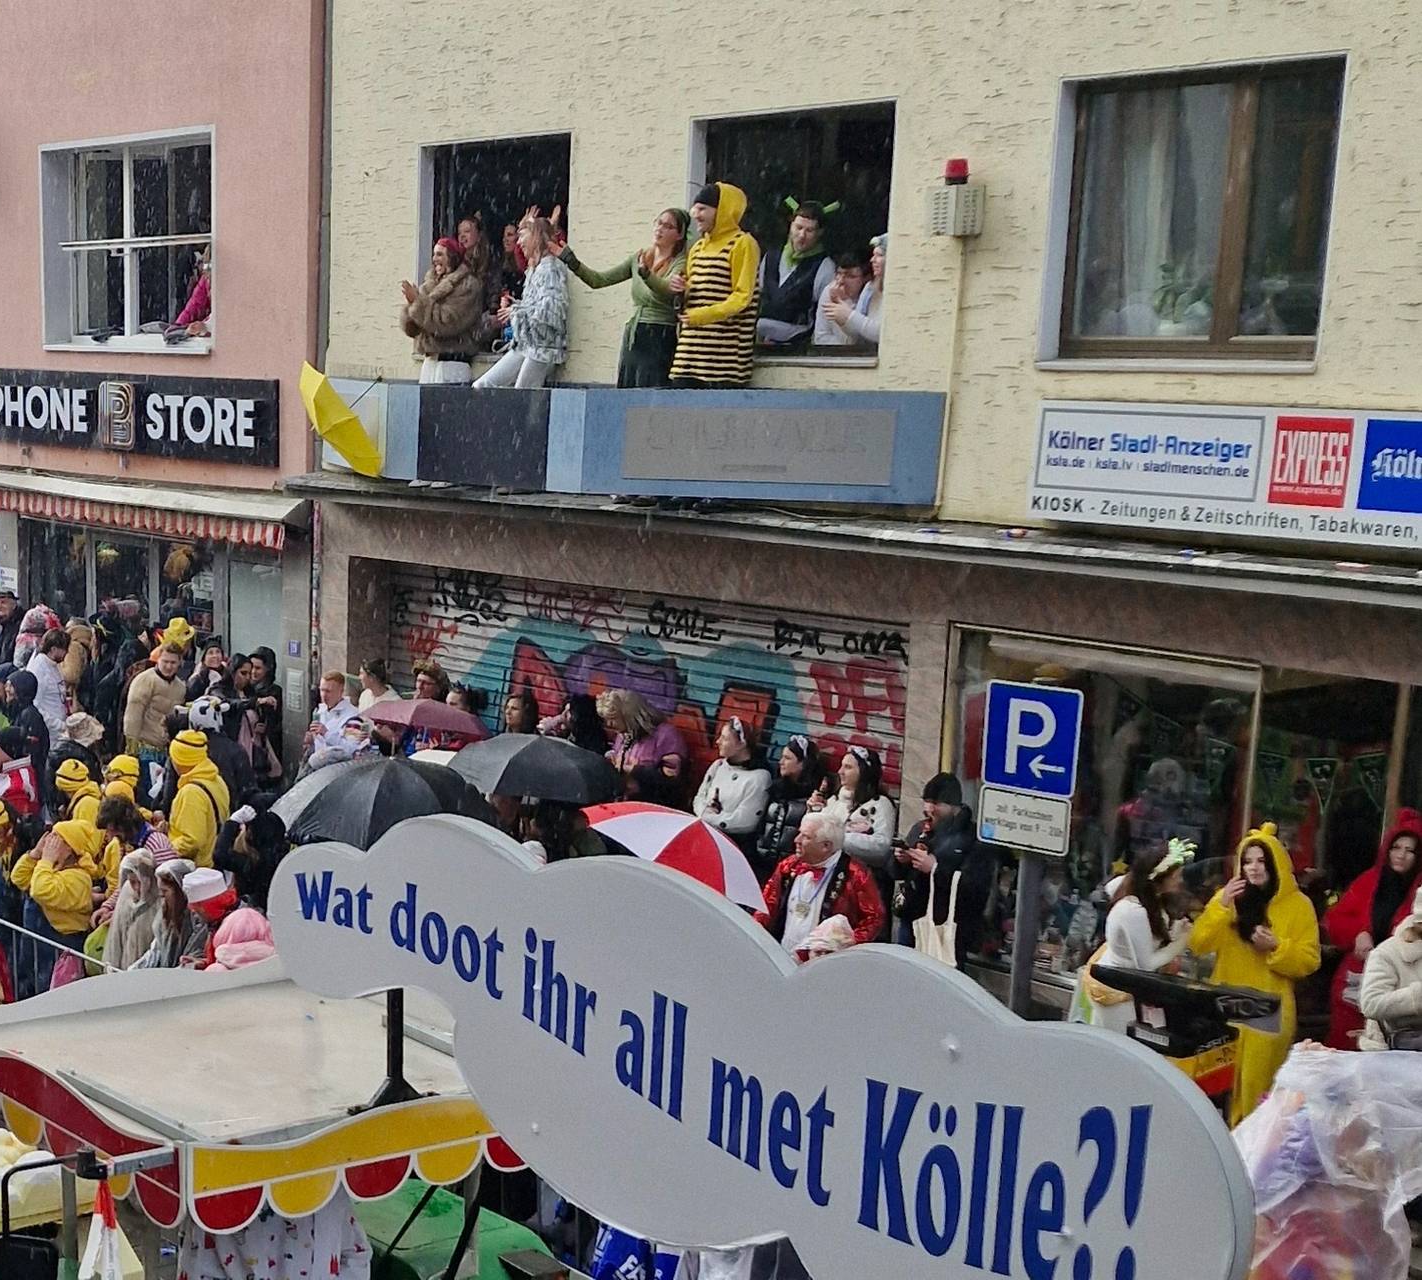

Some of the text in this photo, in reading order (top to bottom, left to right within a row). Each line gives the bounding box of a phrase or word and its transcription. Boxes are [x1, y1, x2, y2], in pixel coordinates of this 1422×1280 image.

[145, 393, 255, 448] STORE
[1048, 430, 1253, 463] Kölner Stadt-Anzeiger
[1046, 454, 1250, 478] ksta.de ksta.tv stadtmenschen.de
[1273, 430, 1350, 487] EXPRESS
[1031, 495, 1084, 513] KIOSK
[1100, 500, 1176, 523] Zeitungen
[1180, 505, 1190, 521] &
[1194, 507, 1304, 532] Zeitschriften,
[1309, 514, 1418, 541] Tabakwaren,
[1004, 697, 1057, 774] P
[294, 870, 1154, 1280] Wat doot ihr all met Kölle?!
